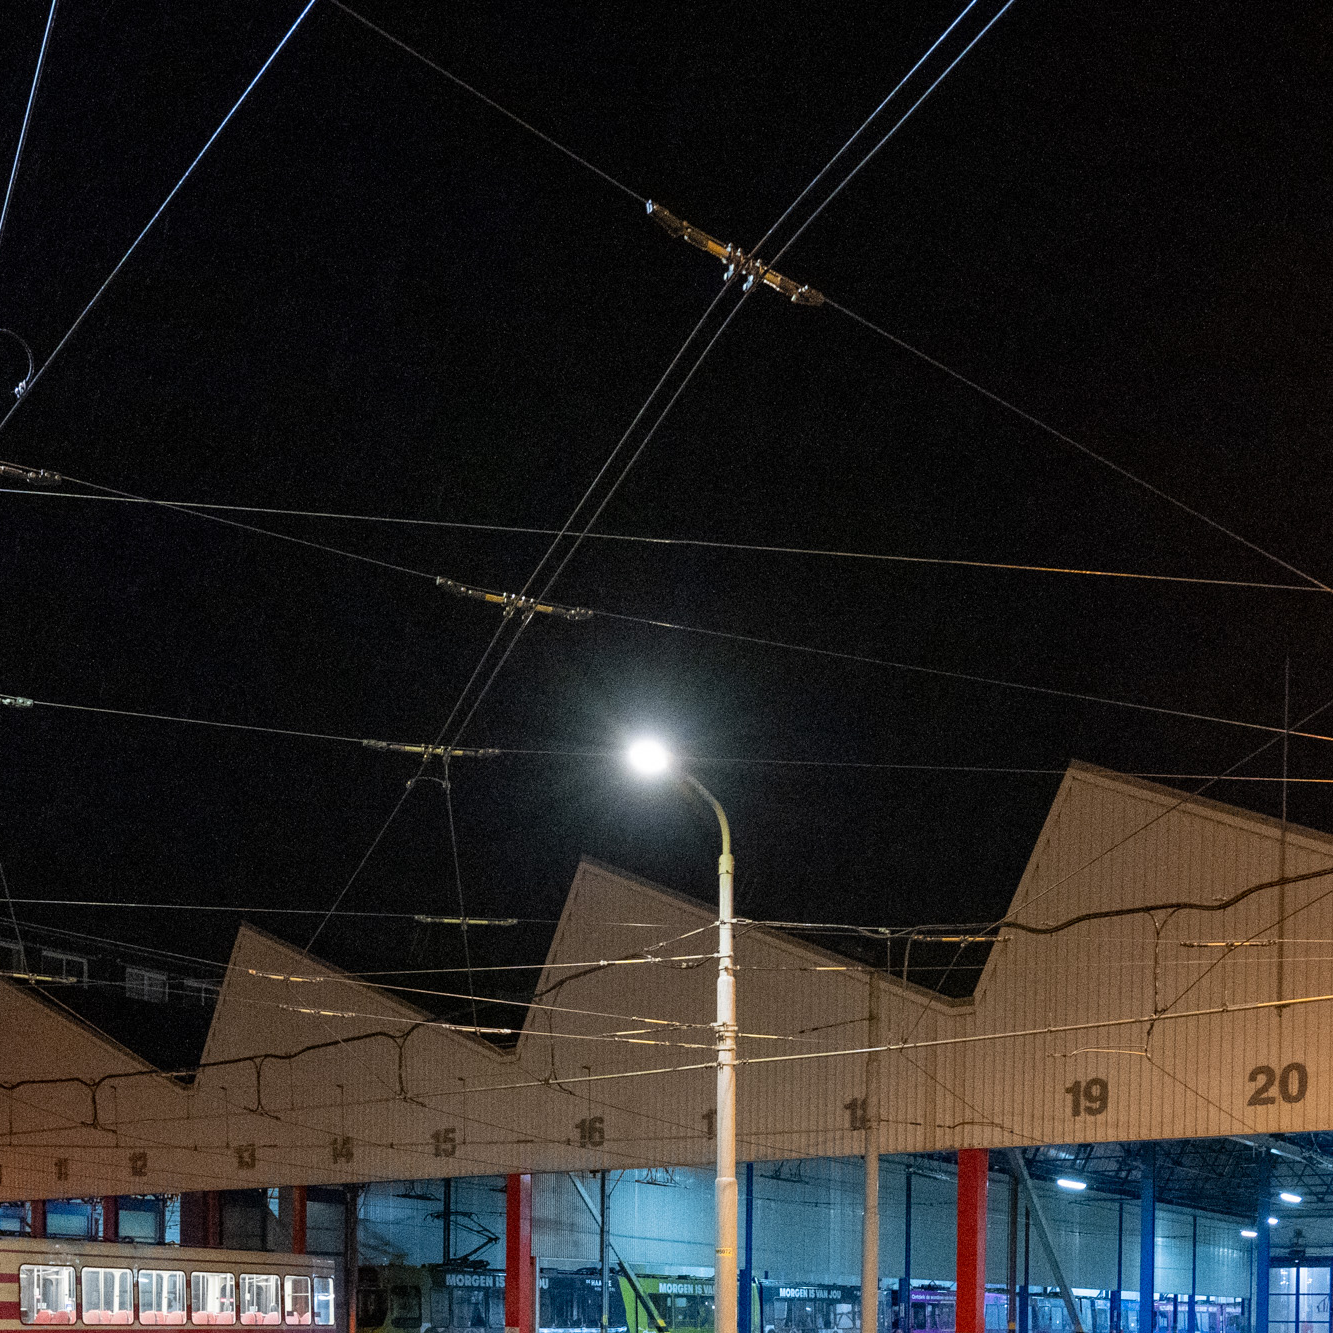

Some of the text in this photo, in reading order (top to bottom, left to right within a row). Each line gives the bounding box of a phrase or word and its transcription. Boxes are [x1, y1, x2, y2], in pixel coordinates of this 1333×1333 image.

[1065, 1077, 1109, 1117] 19
[1247, 1063, 1308, 1106] 20
[574, 1116, 605, 1148] 16
[702, 1108, 718, 1140] 1
[237, 1143, 256, 1169] 13
[331, 1136, 354, 1164] 14
[431, 1128, 457, 1158] 15
[129, 1151, 148, 1177] 12
[446, 1274, 494, 1287] MORGEN
[495, 1275, 506, 1288] IS
[659, 1282, 694, 1294] MORGEN
[695, 1284, 703, 1294] IS
[779, 1287, 842, 1299] MORGEN IS VAN JOU
